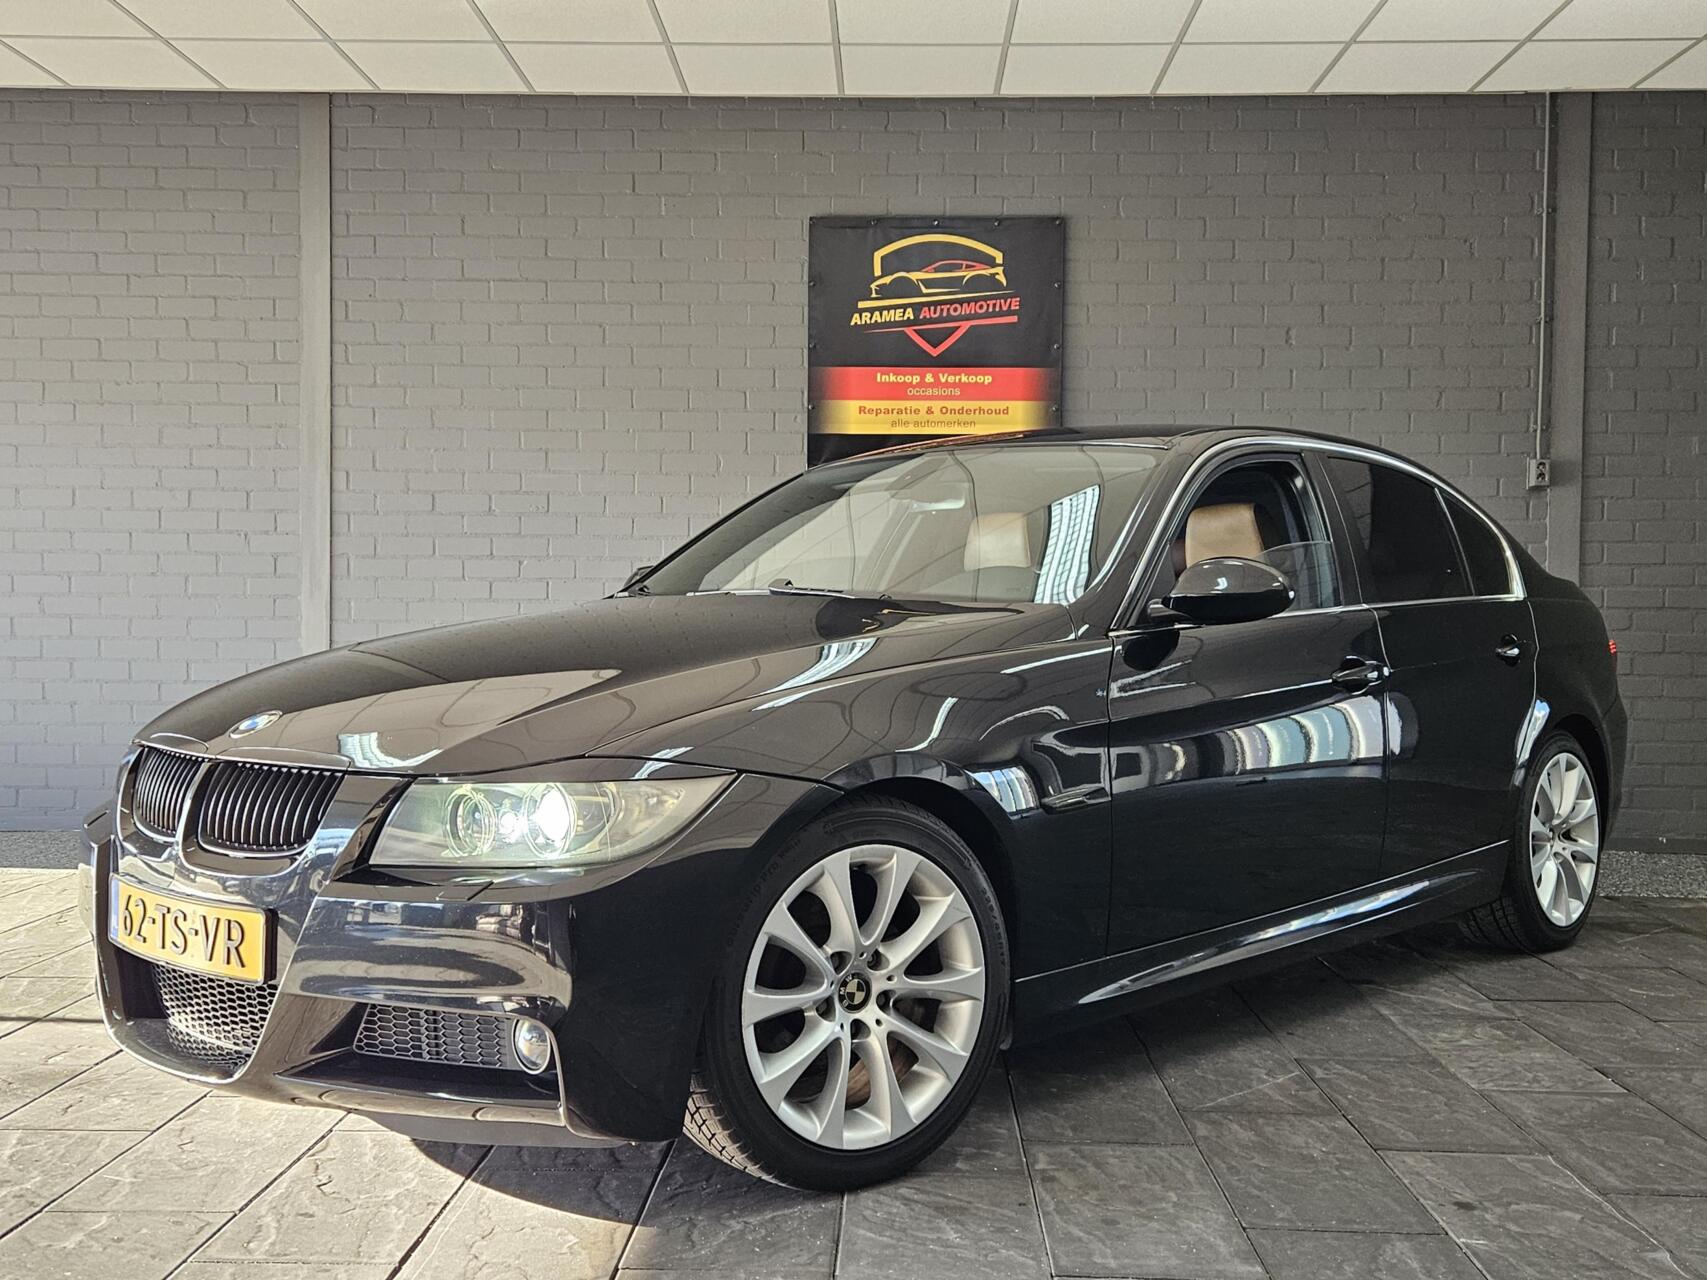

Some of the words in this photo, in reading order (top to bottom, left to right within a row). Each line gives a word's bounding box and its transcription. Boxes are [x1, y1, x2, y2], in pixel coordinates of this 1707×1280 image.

[850, 308, 915, 326] ARAMEA
[919, 297, 1021, 319] AUTOMOTIVE
[876, 372, 921, 384] Inkoop
[925, 372, 935, 383] &
[939, 372, 993, 384] Verkoop
[907, 386, 961, 396] occasions
[858, 405, 921, 416] Reparatie
[925, 406, 935, 415] &
[939, 405, 1010, 416] Onderhoud
[890, 418, 910, 428] alle
[912, 418, 976, 428] automerken
[122, 894, 246, 969] 62-TS-VR
